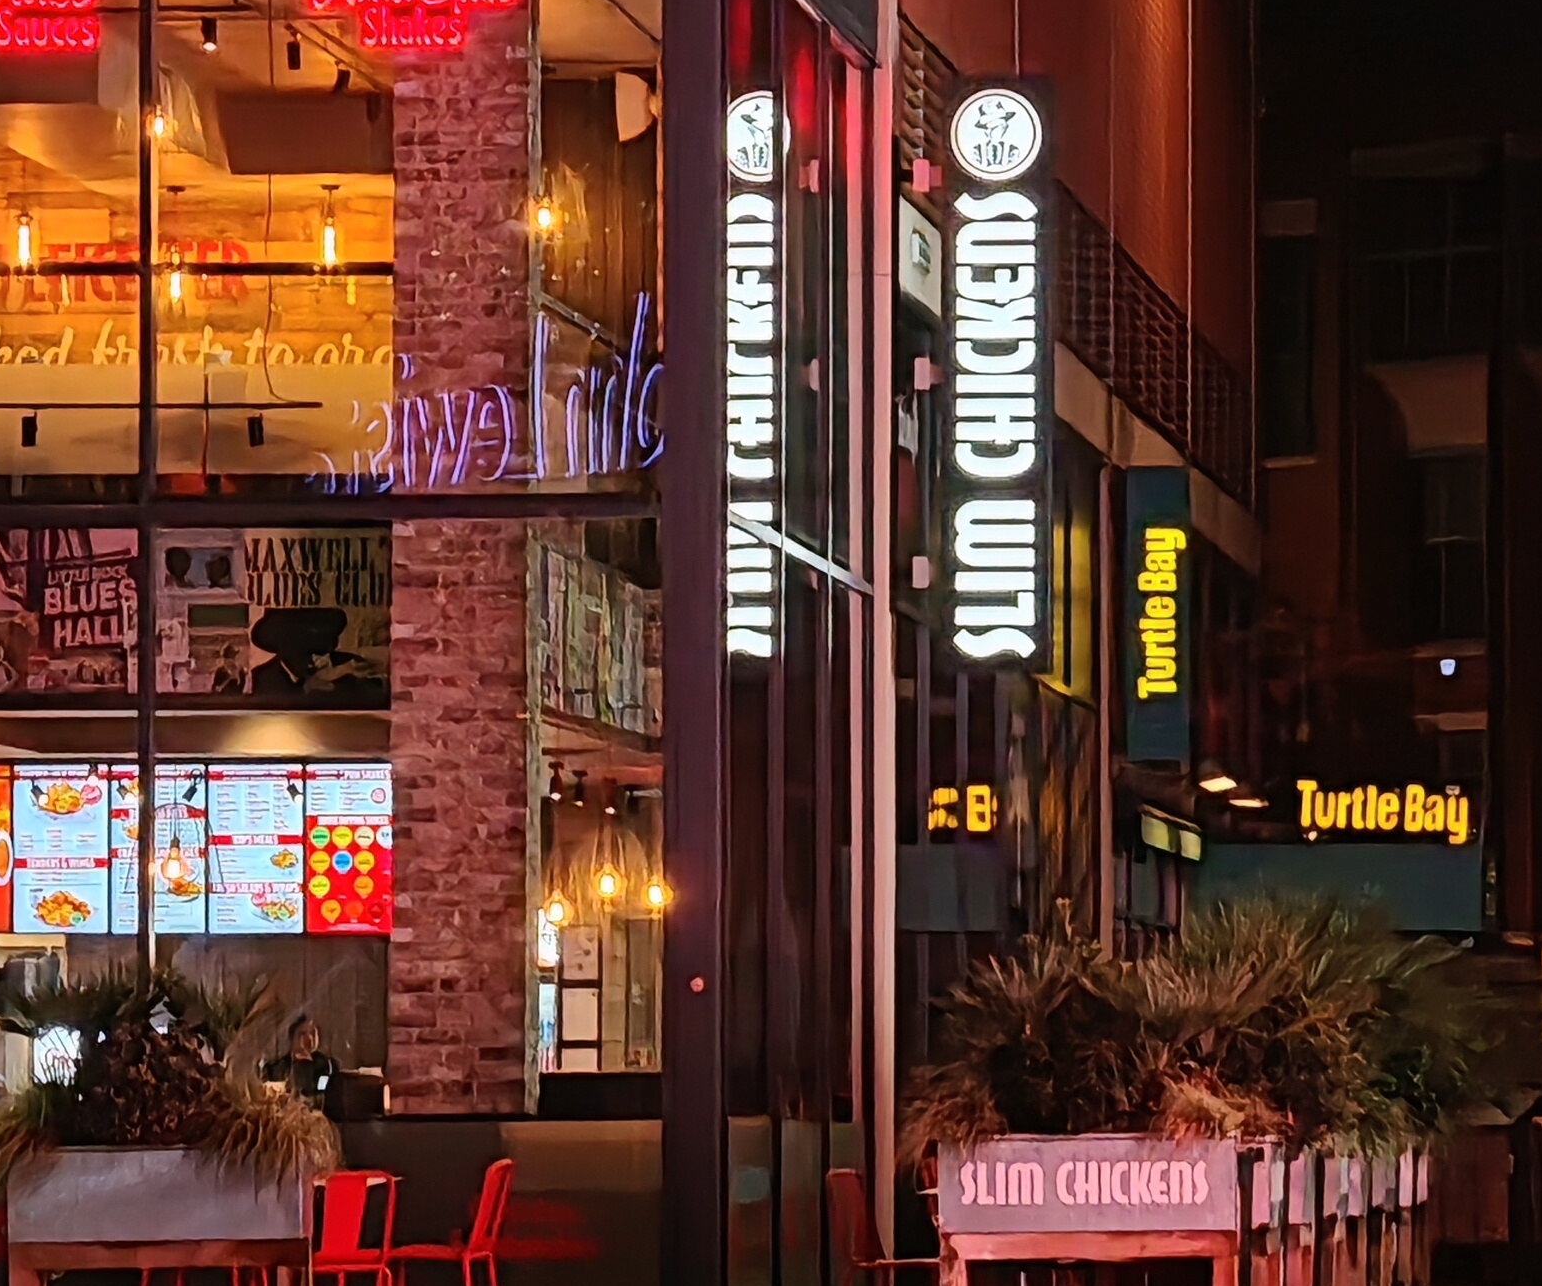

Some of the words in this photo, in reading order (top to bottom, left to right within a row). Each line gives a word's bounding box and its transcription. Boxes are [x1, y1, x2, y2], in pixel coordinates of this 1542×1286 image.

[360, 8, 464, 49] Shakes
[244, 326, 297, 365] to
[954, 191, 1039, 479] CHICKENS
[954, 500, 1037, 658] SLIM
[1137, 527, 1187, 593] Bay
[44, 577, 138, 615] BLUES
[53, 614, 124, 649] HALL
[1137, 596, 1178, 700] Turtle
[1296, 778, 1399, 831] Turtle
[1403, 784, 1469, 845] Bay
[960, 1161, 1045, 1206] SLIM
[1055, 1160, 1210, 1206] CHICKENS
